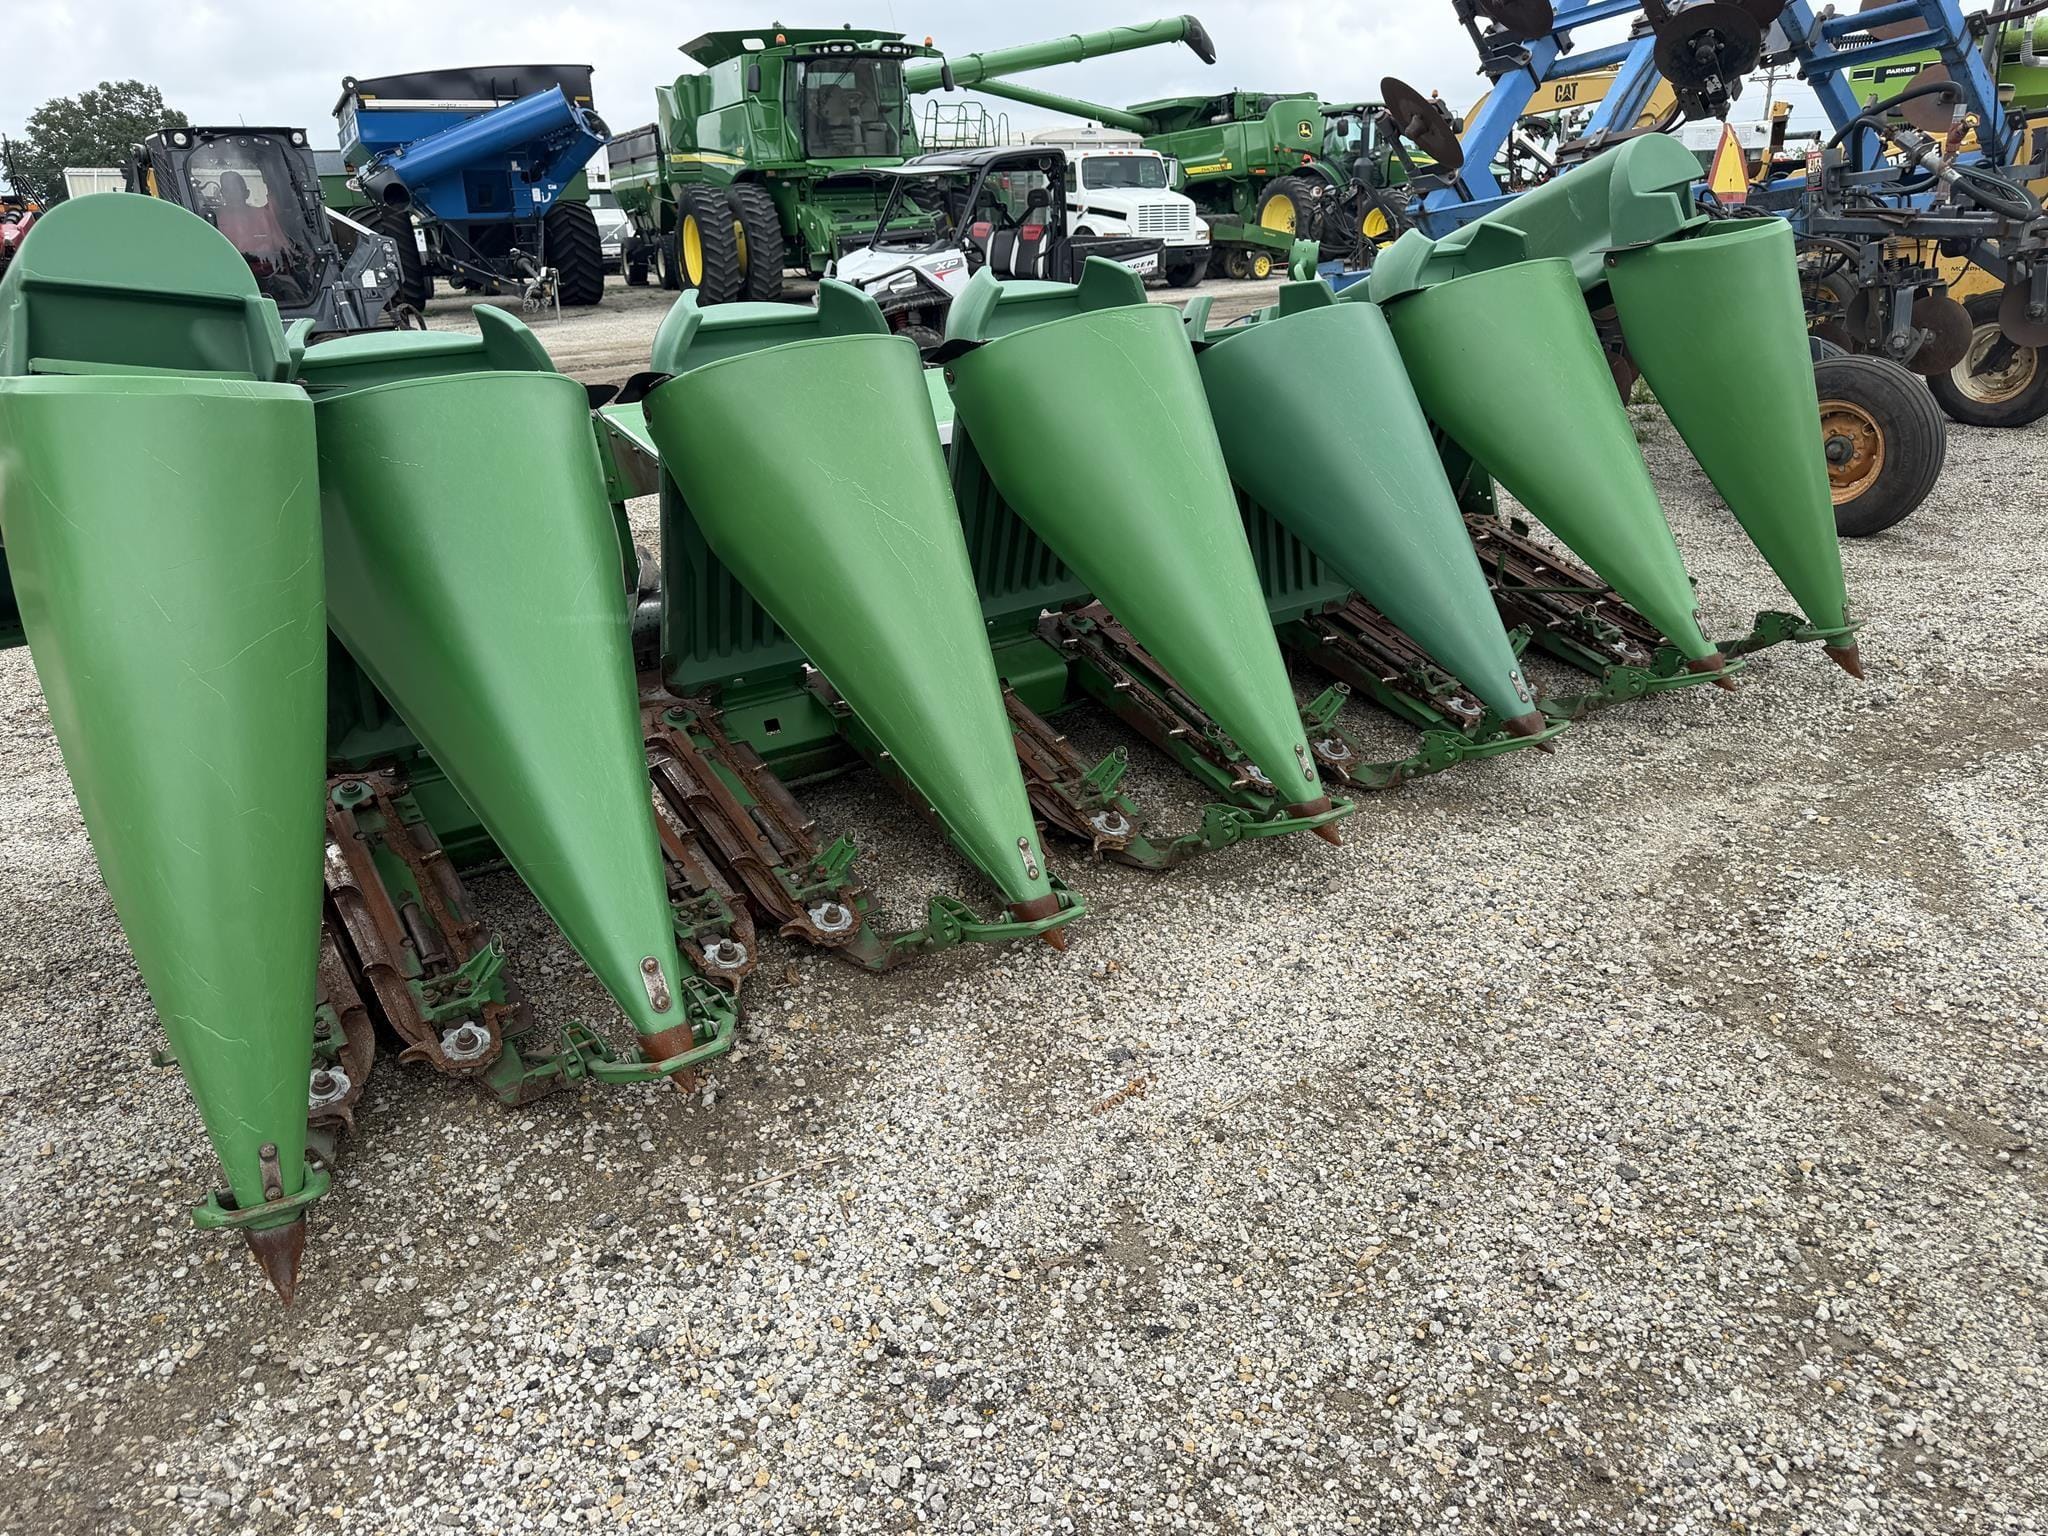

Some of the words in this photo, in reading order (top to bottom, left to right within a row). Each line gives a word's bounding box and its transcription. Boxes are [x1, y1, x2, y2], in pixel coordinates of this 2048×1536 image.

[1886, 66, 1916, 75] PARKER
[1555, 82, 1579, 103] CAT
[935, 259, 958, 271] XP
[1127, 260, 1154, 269] NGER
